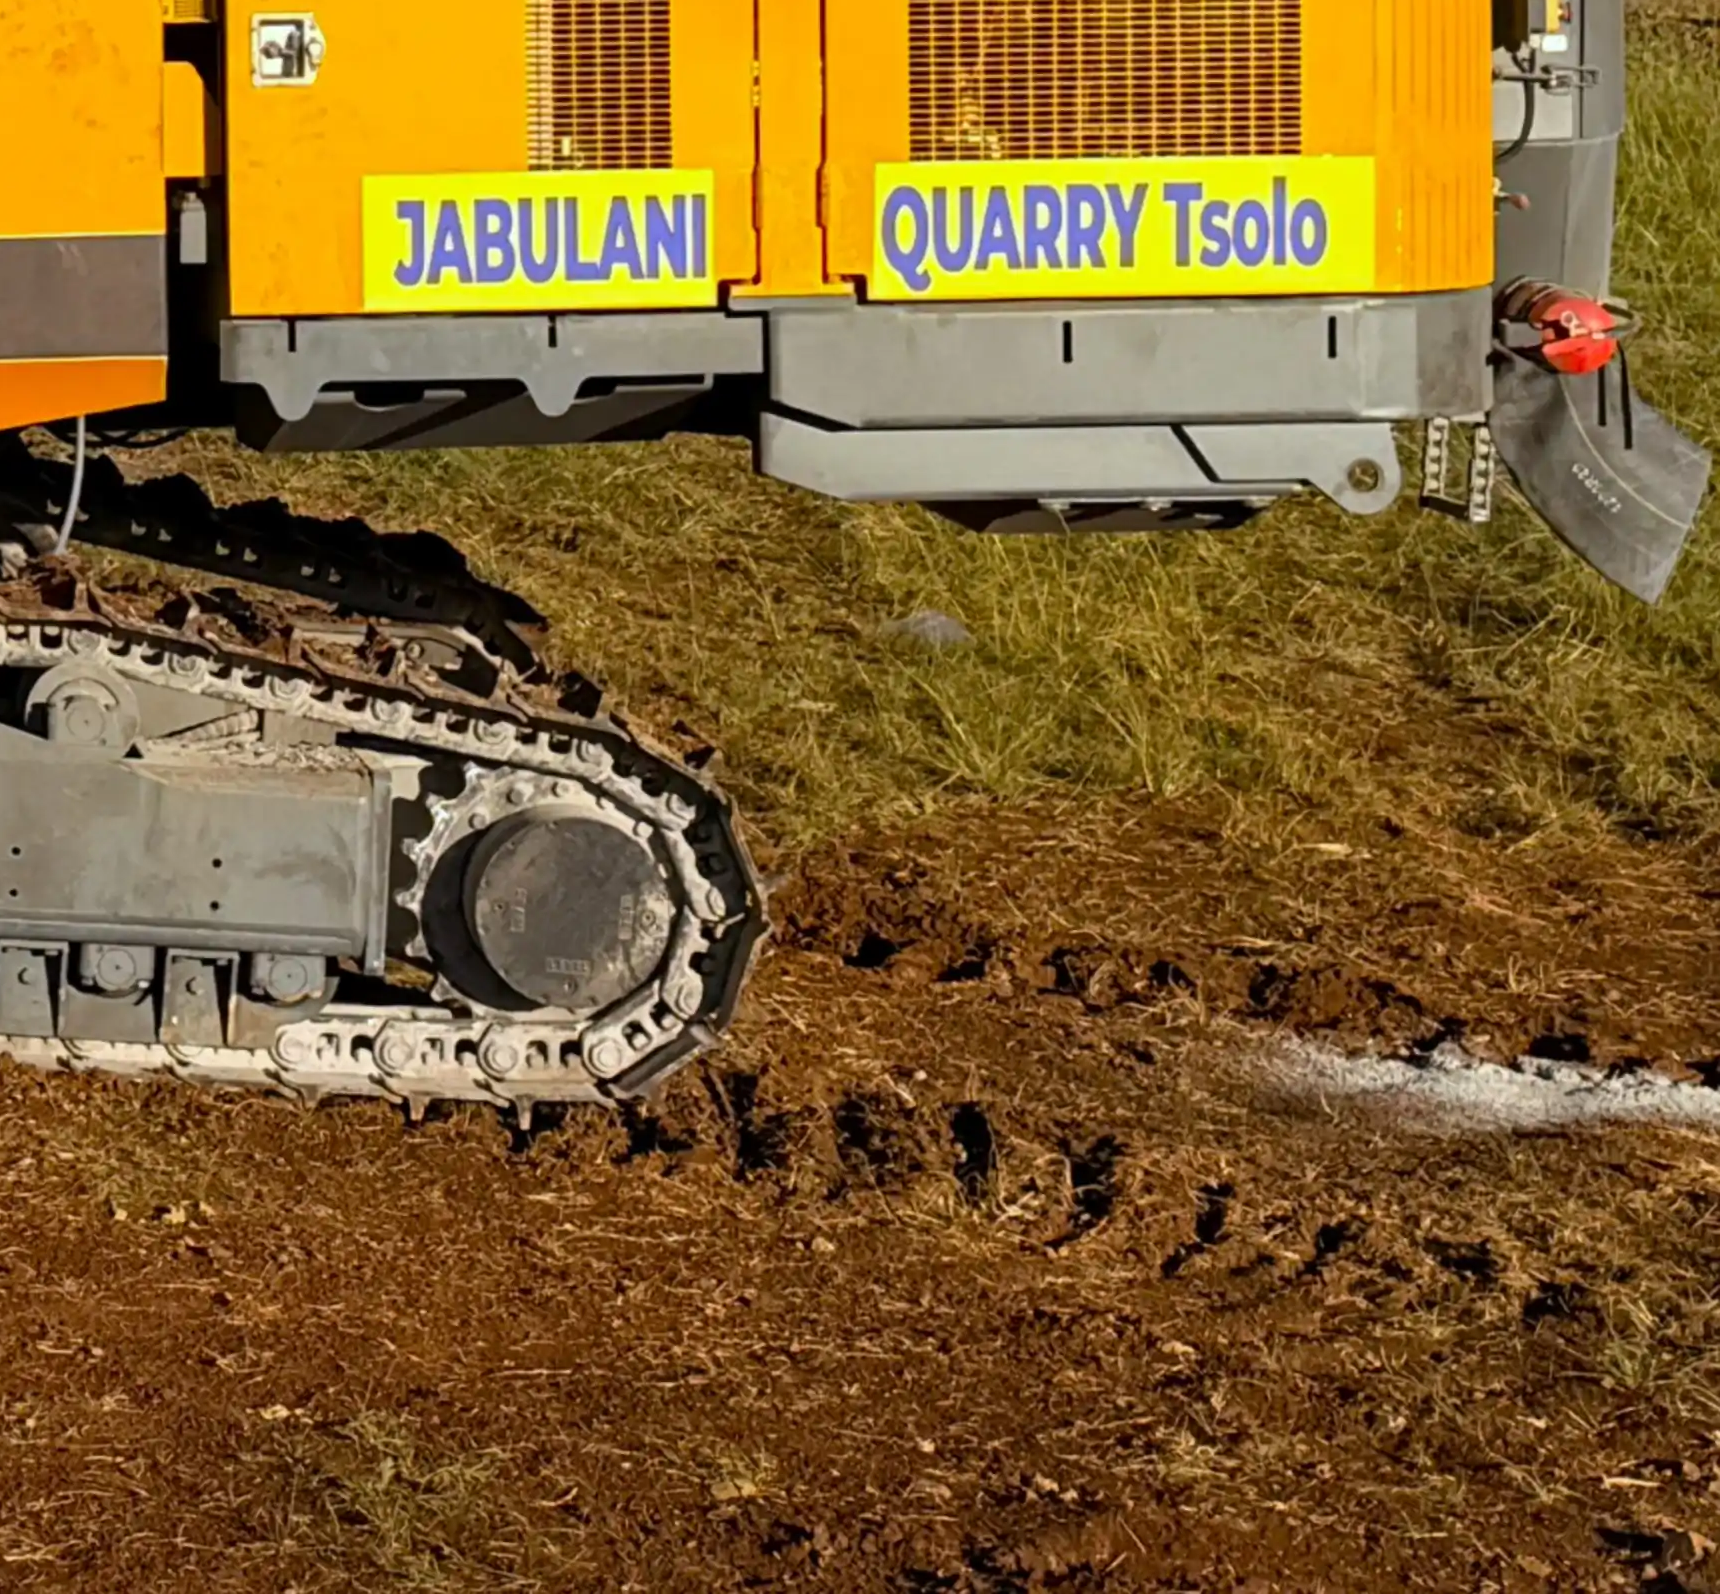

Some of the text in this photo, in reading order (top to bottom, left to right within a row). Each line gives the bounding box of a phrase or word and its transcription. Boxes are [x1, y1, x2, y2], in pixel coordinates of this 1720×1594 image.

[393, 193, 707, 286] JABULANI
[881, 175, 1328, 292] QUARRY Tsolo
